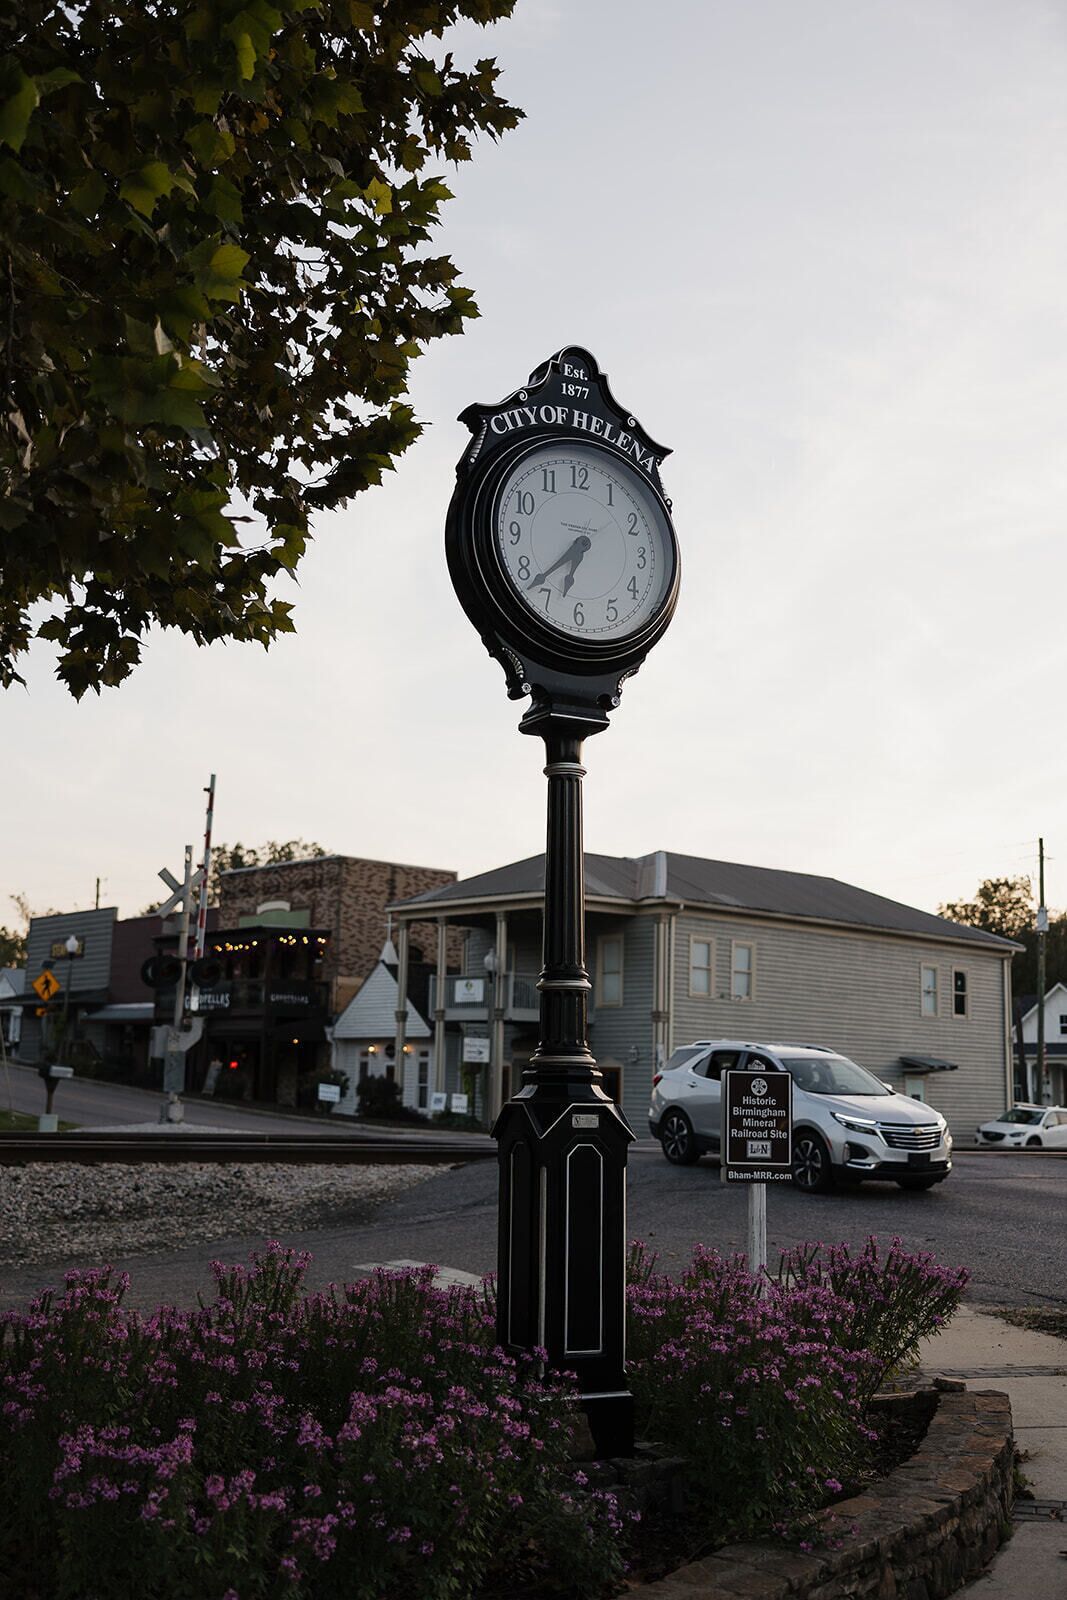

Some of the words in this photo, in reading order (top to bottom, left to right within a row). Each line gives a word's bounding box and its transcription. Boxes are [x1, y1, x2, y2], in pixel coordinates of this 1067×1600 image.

[563, 363, 588, 381] Est.
[561, 383, 589, 399] 1877
[490, 406, 538, 435] CITY
[539, 405, 569, 425] OF
[571, 409, 655, 474] HELENA
[541, 468, 558, 493] 11
[570, 465, 590, 490] 12
[515, 490, 535, 515] 10
[606, 483, 615, 507] 1
[509, 521, 520, 545] 9
[627, 512, 639, 536] 2
[517, 555, 530, 581] 8
[637, 546, 646, 570] 3
[627, 575, 639, 600] 4
[538, 587, 552, 614] 7
[606, 597, 618, 622] 5
[573, 602, 585, 627] 6
[732, 1107, 786, 1118] Birmingham
[742, 1096, 777, 1105] Historic
[731, 1129, 768, 1138] Railroad
[770, 1130, 788, 1139] Site
[742, 1118, 776, 1127] Mineral
[728, 1170, 792, 1180] Bham-MRR.com
